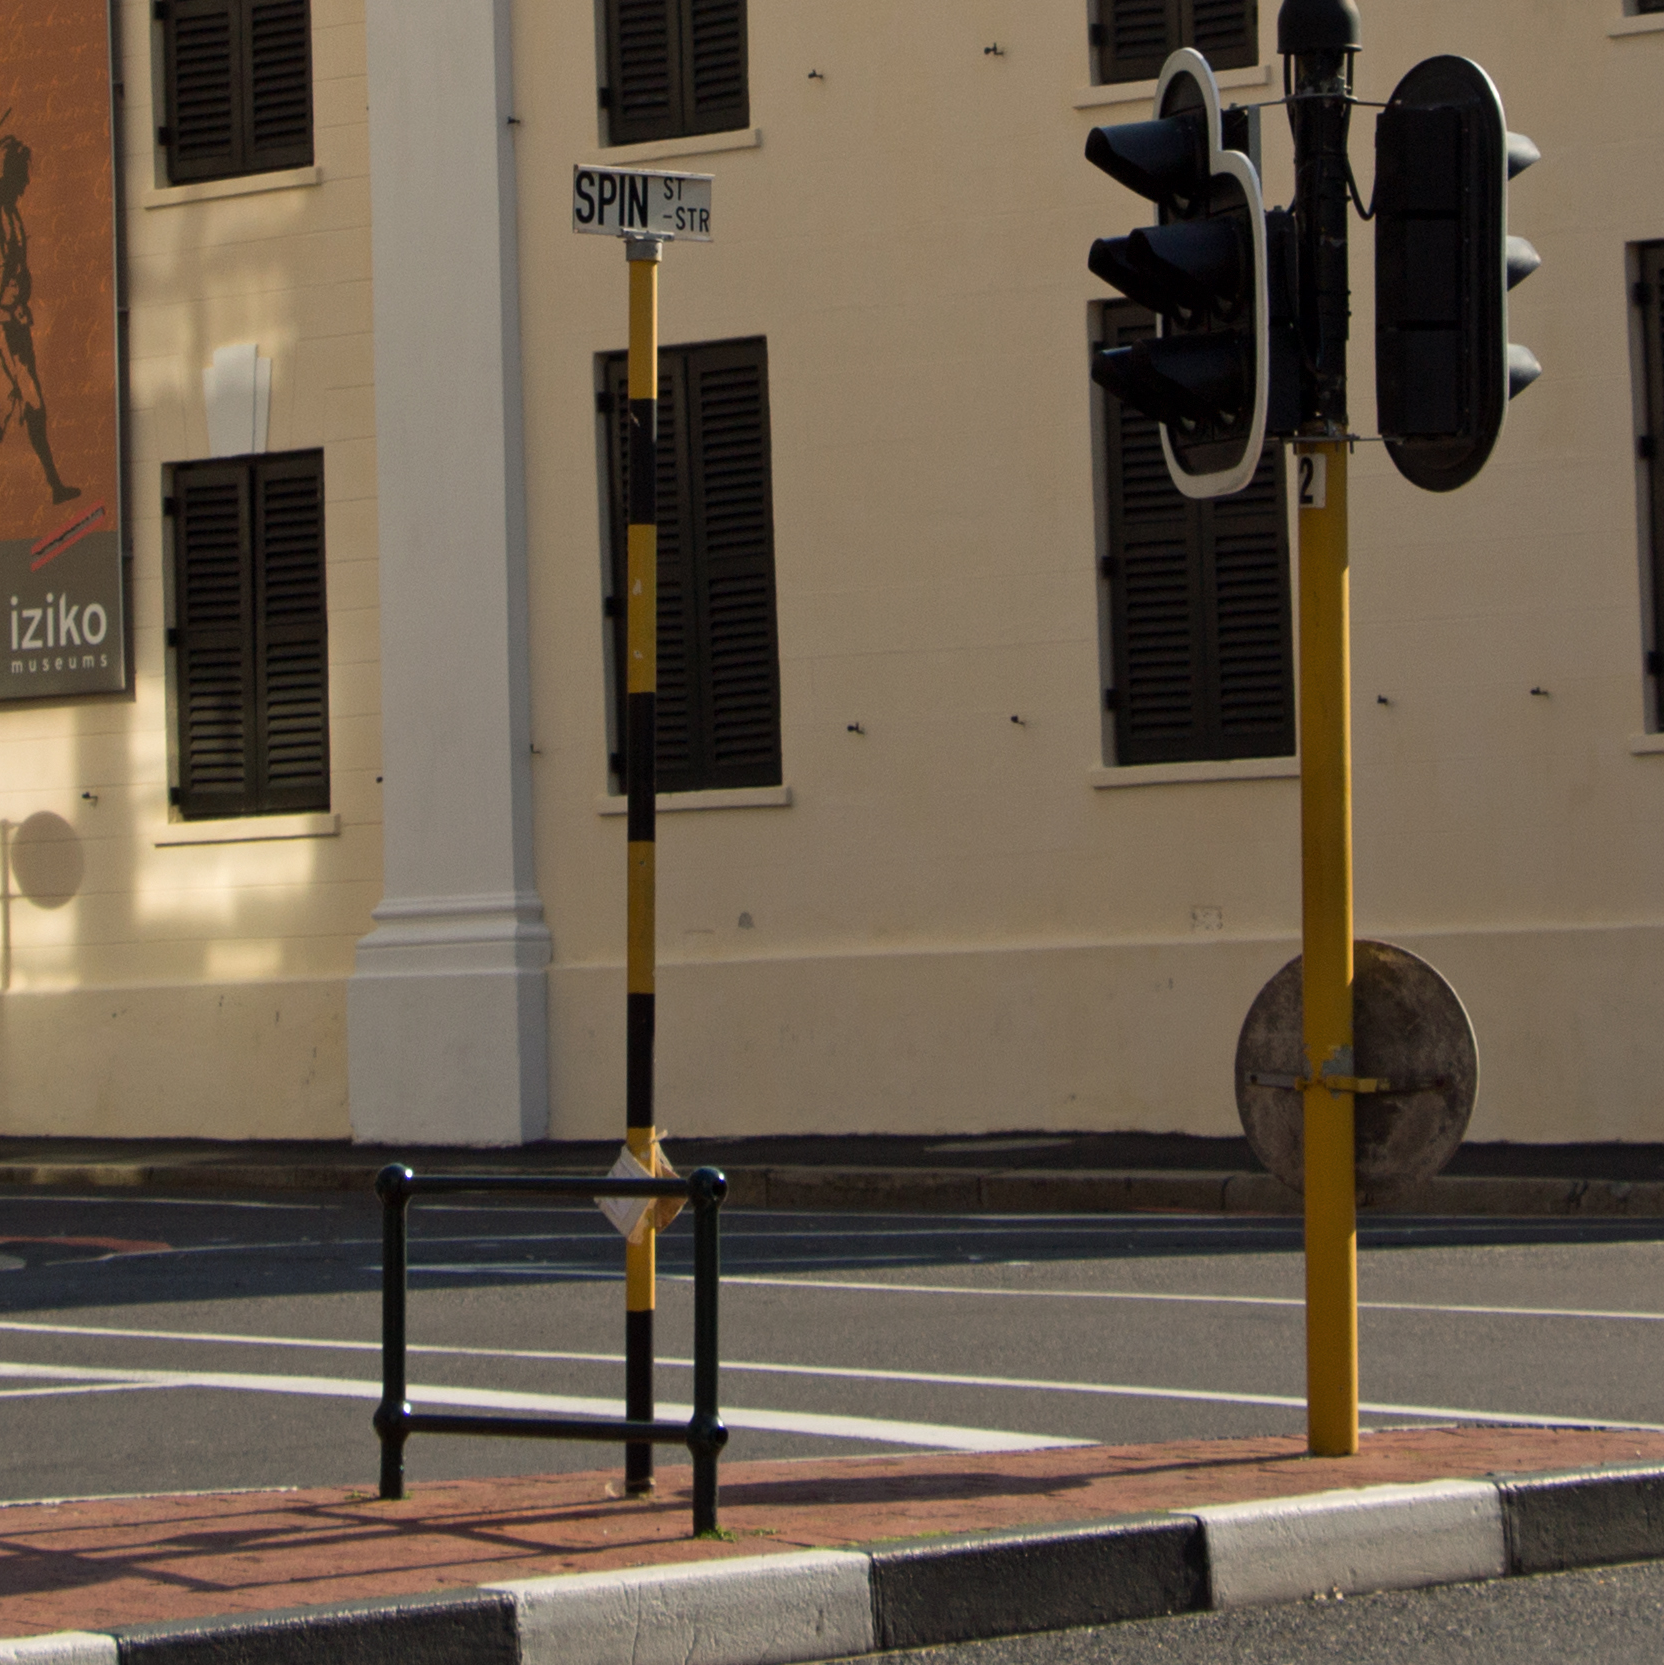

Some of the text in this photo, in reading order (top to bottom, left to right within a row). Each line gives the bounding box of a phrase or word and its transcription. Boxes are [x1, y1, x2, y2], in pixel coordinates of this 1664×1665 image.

[575, 171, 685, 228] SPIN ST
[1299, 457, 1314, 504] 2
[10, 592, 107, 651] iziko
[11, 654, 108, 674] museums
